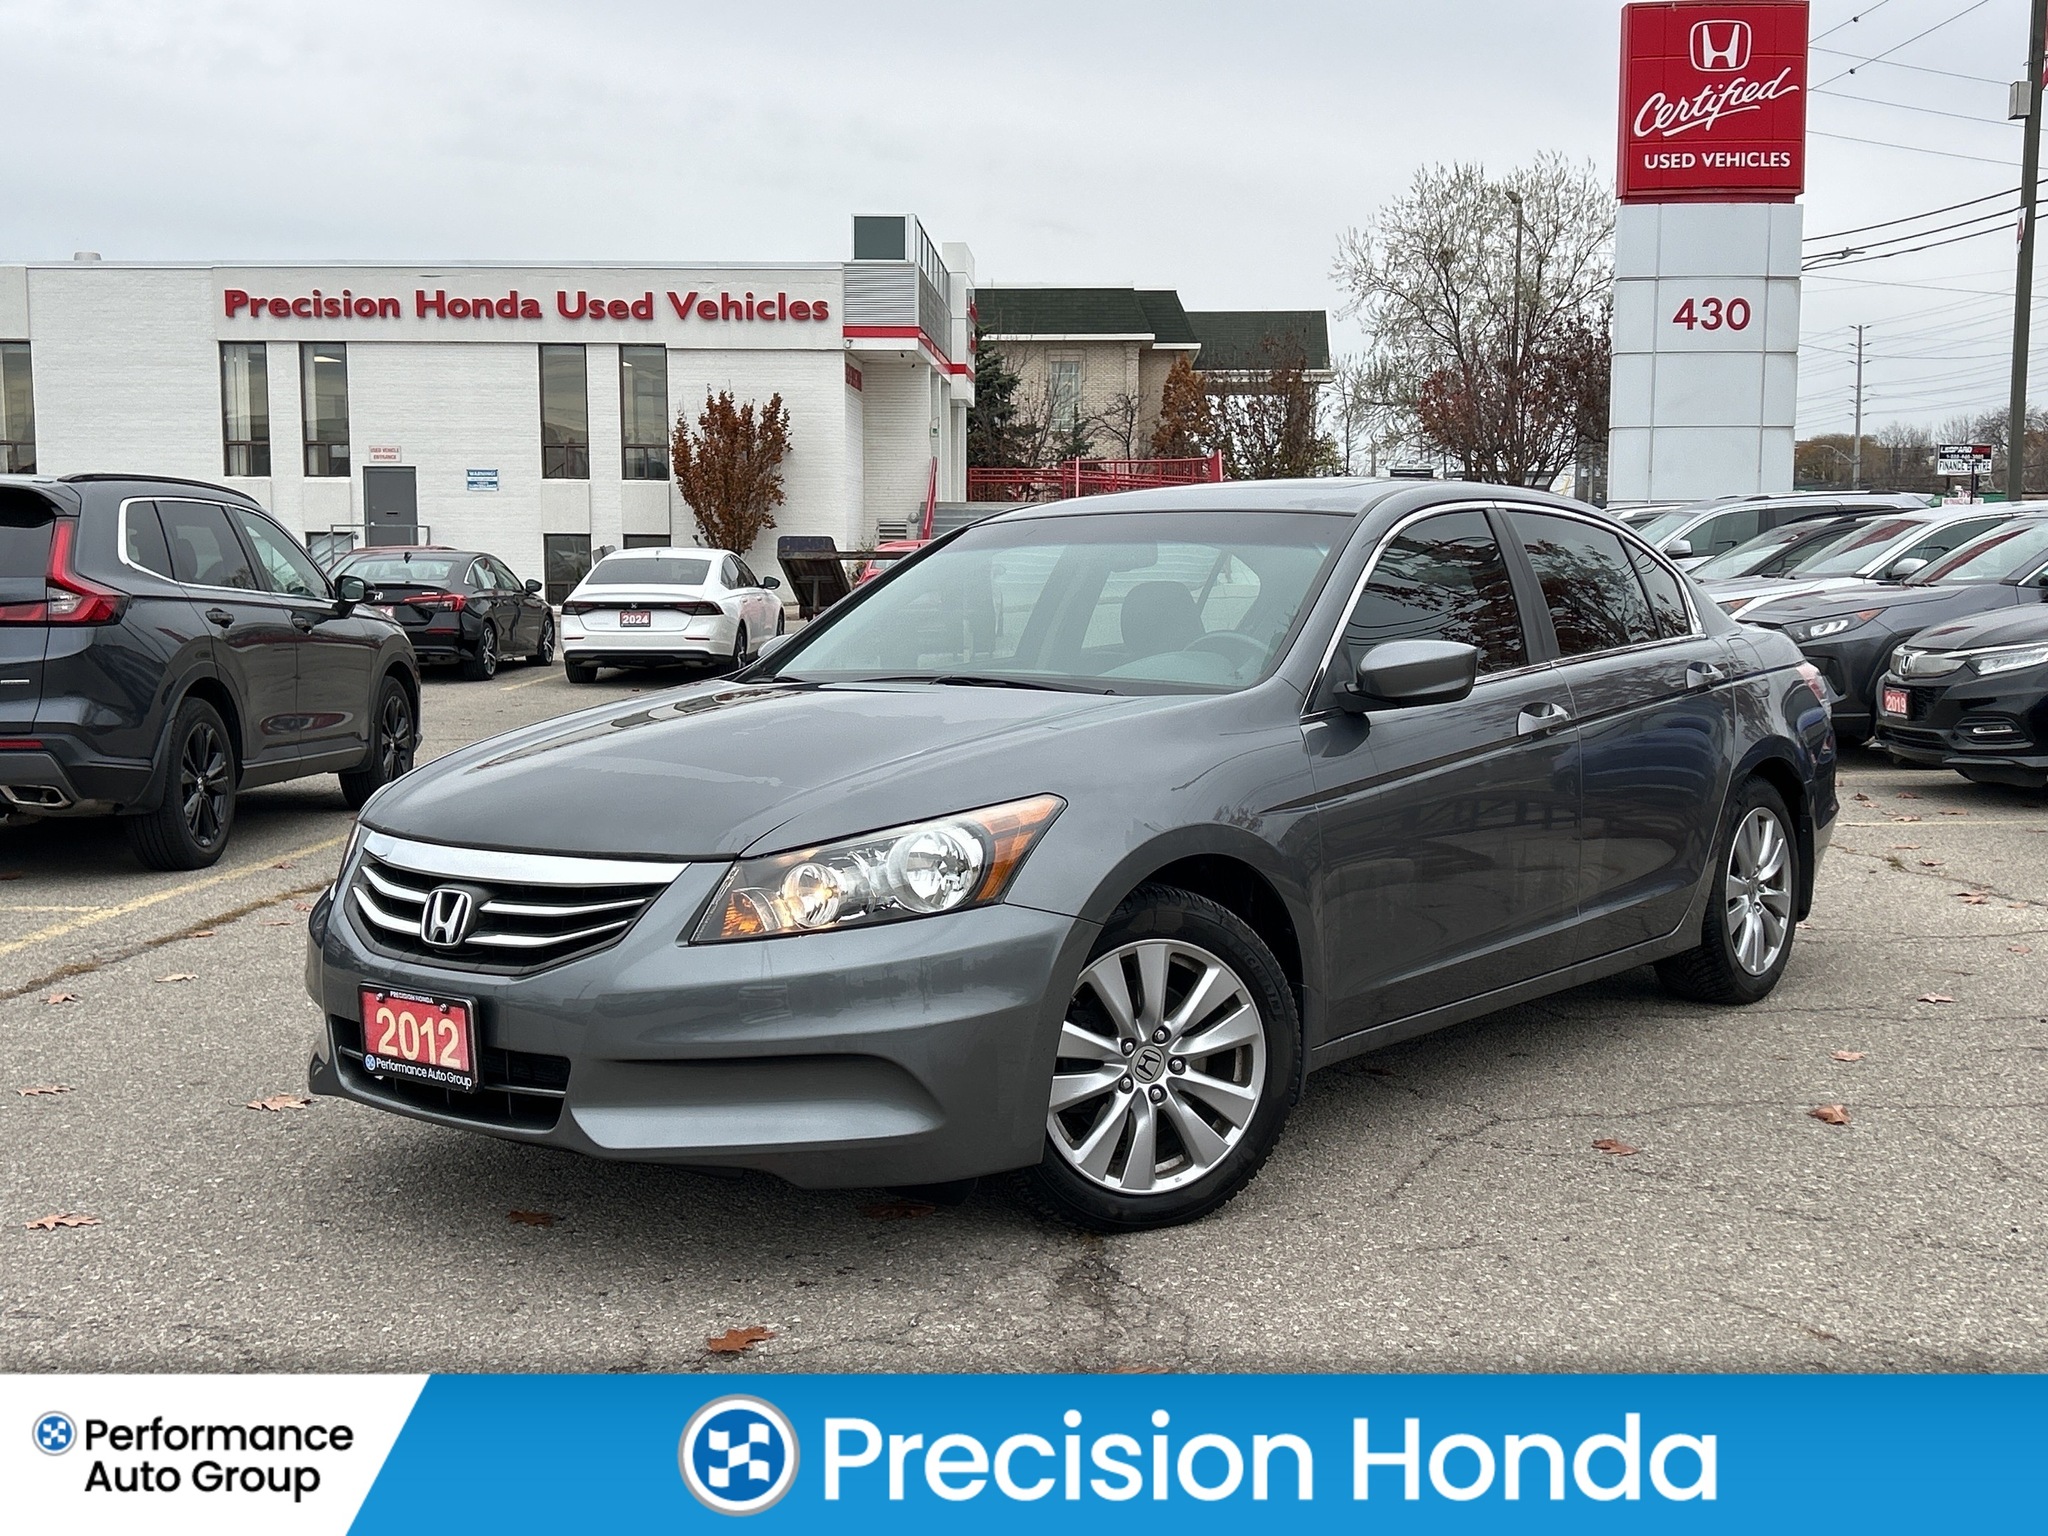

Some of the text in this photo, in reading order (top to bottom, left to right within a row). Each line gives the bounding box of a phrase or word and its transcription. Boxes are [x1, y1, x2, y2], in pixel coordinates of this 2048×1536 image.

[1633, 66, 1799, 137] Certified
[1644, 151, 1791, 169] USED VEHICLES
[223, 288, 830, 322] Precision Honda Used Vehicles
[1673, 298, 1751, 330] 430
[622, 615, 649, 624] 2024
[1885, 695, 1907, 714] 2019
[376, 1007, 462, 1070] 2012
[376, 1057, 472, 1090] Performance Auto Group
